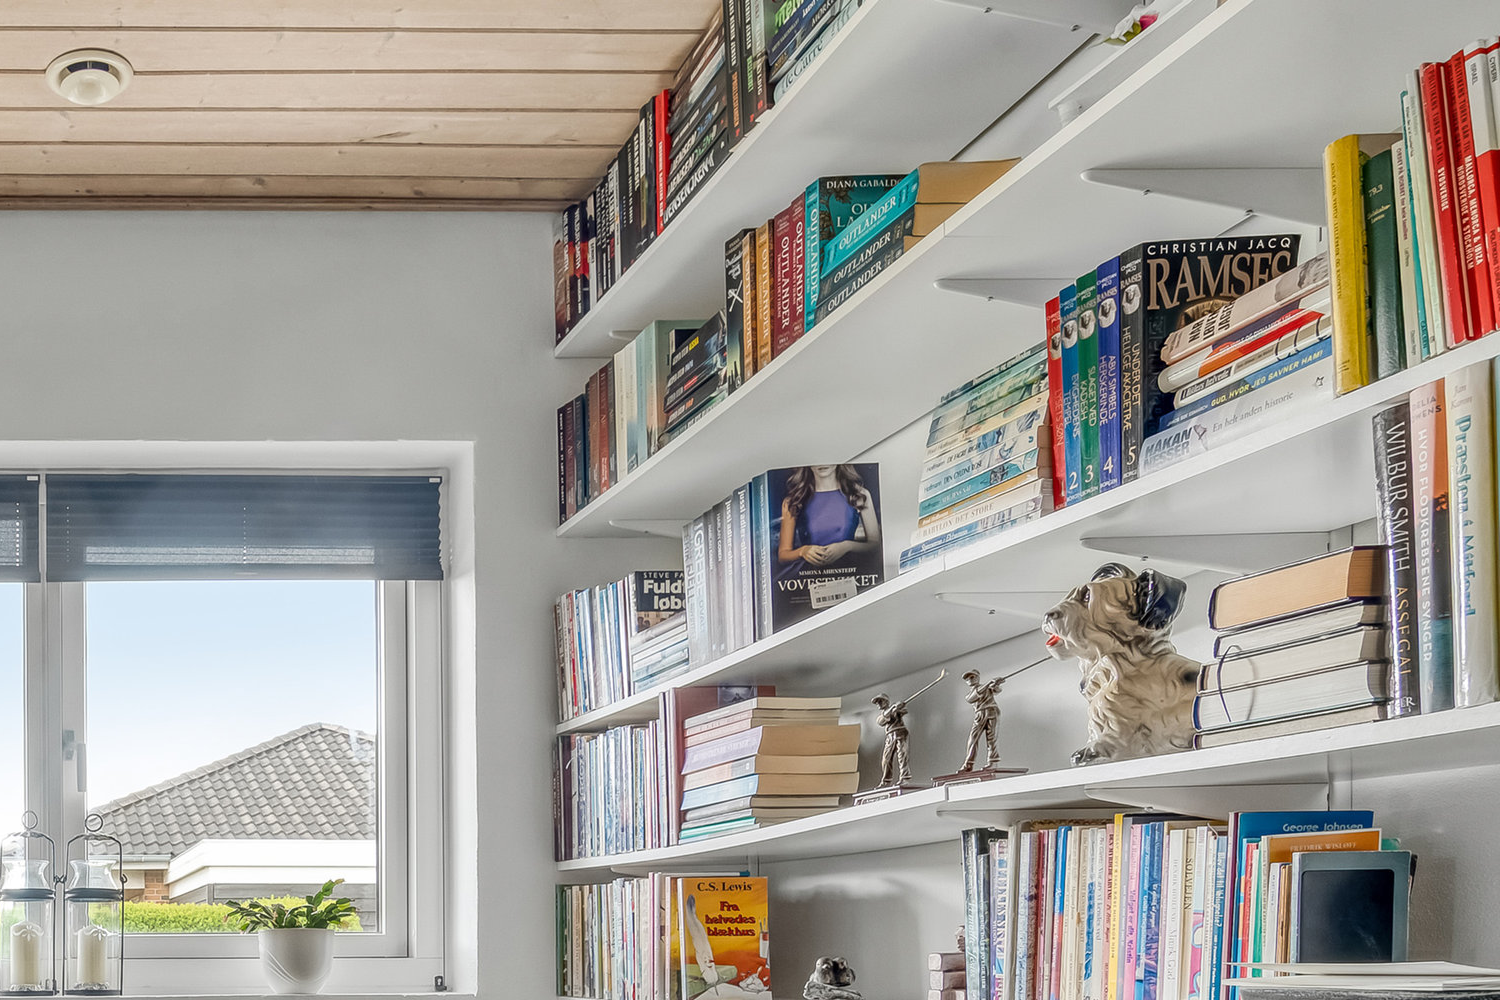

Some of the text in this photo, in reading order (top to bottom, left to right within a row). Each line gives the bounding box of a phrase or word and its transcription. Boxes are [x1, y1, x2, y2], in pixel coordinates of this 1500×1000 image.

[1470, 62, 1478, 86] ISRAEL
[1489, 56, 1498, 83] CYPERN
[826, 180, 858, 189] DIANA
[1437, 167, 1449, 211] SYDSVERIGE
[839, 195, 896, 250] OUTLANDER
[1469, 198, 1480, 235] MENORCA
[810, 208, 818, 307] OUTLANDER
[834, 232, 891, 284] OUTLANDER
[1147, 237, 1291, 256] CHRISTIAN JACQ
[1463, 224, 1475, 270] STOCKHOLM
[1474, 243, 1484, 266] IBIZA
[781, 236, 790, 329] OUTLANDER
[828, 264, 882, 311] OUTLANDER
[1122, 325, 1132, 367] HELLIGE
[1132, 343, 1141, 407] UNDER DET
[1229, 384, 1249, 398] HVOR
[1251, 377, 1266, 388] JEG
[1268, 361, 1299, 381] SAVNER
[1063, 391, 1072, 427] TEMPEL
[1072, 373, 1080, 439] EVIGHEDENS
[1080, 380, 1088, 421] KADESH
[1213, 423, 1222, 433] En
[1265, 392, 1294, 410] historie
[1103, 456, 1113, 475] 4
[1128, 444, 1136, 466] 5
[1069, 471, 1078, 490] 2
[1085, 465, 1094, 484] 3
[972, 503, 994, 518] STORE
[1386, 422, 1413, 674] WILBUR SMITH ASSEGAI
[1417, 428, 1434, 662] HVOR FLODKREBSENE SYNGER
[1463, 534, 1477, 617] Mitford
[1283, 822, 1364, 832] George Johnsen
[697, 881, 752, 892] C.S. Lewis
[705, 914, 756, 925] helvedes
[720, 901, 740, 911] Fra
[707, 927, 756, 937] blækhus
